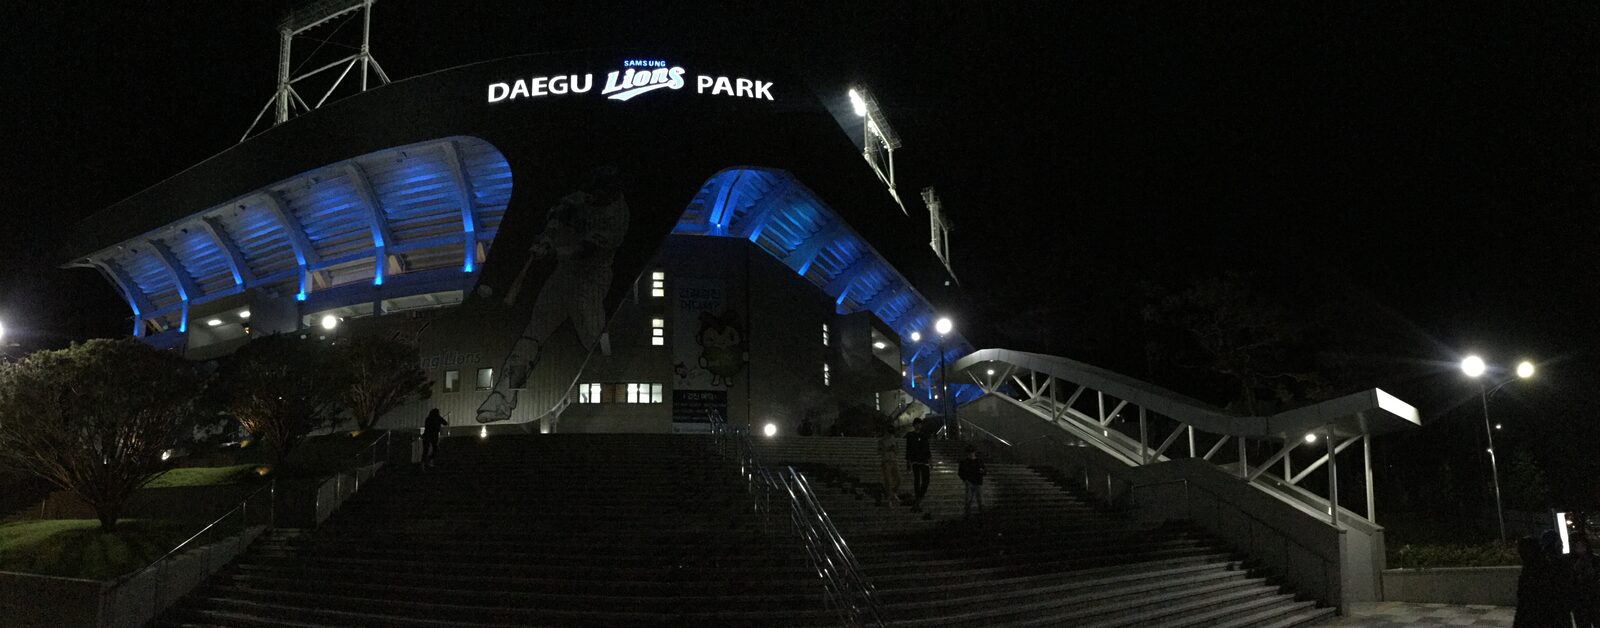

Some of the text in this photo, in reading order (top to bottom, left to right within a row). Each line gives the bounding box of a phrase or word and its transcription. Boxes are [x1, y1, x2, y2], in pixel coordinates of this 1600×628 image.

[624, 59, 667, 68] SAMSUNG
[488, 66, 774, 103] DAEGU Lions PARK
